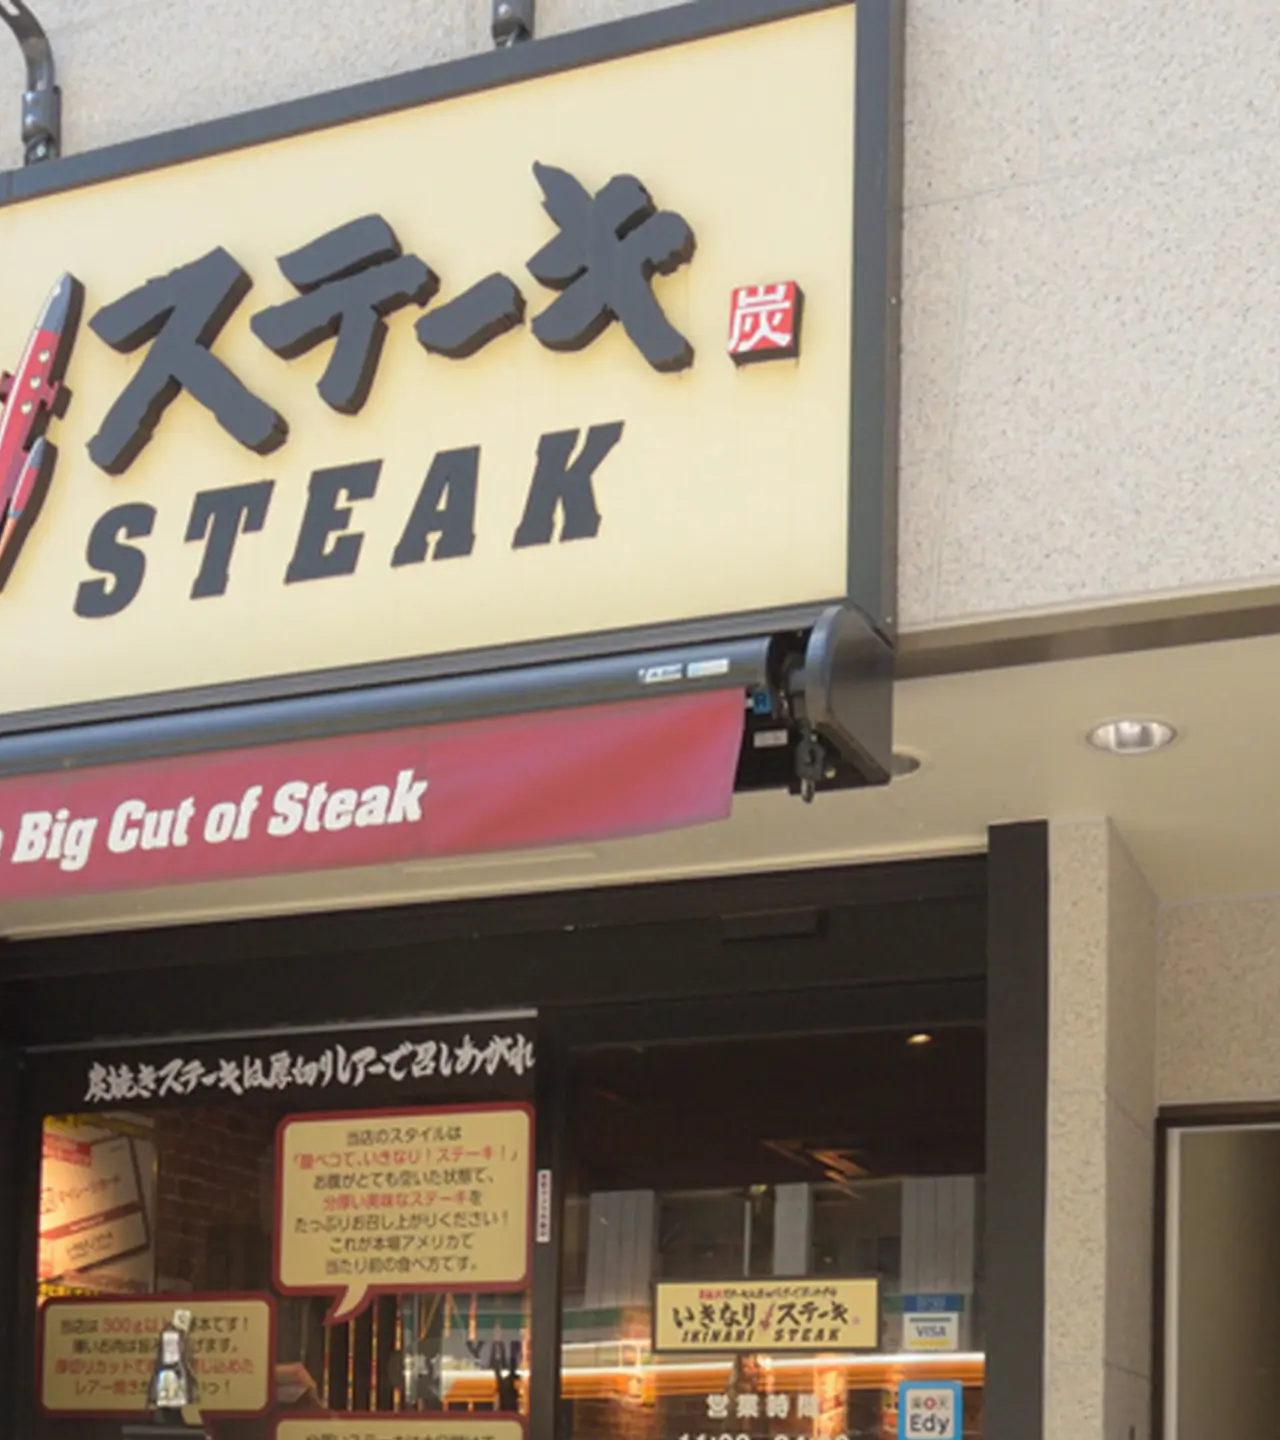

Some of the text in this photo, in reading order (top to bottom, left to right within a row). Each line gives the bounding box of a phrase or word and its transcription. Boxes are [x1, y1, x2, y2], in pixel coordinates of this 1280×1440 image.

[87, 158, 697, 474] ステーキ
[731, 284, 795, 352] 炭
[74, 421, 624, 616] STEAK
[12, 812, 92, 872] Big
[105, 800, 197, 858] Cut
[203, 792, 260, 845] of
[270, 770, 426, 838] Steak
[672, 1301, 850, 1329] いきなり ステーキ
[681, 1328, 841, 1343] IKINARI STEAK
[705, 1393, 822, 1419] 営業時間
[910, 1415, 951, 1436] Edy
